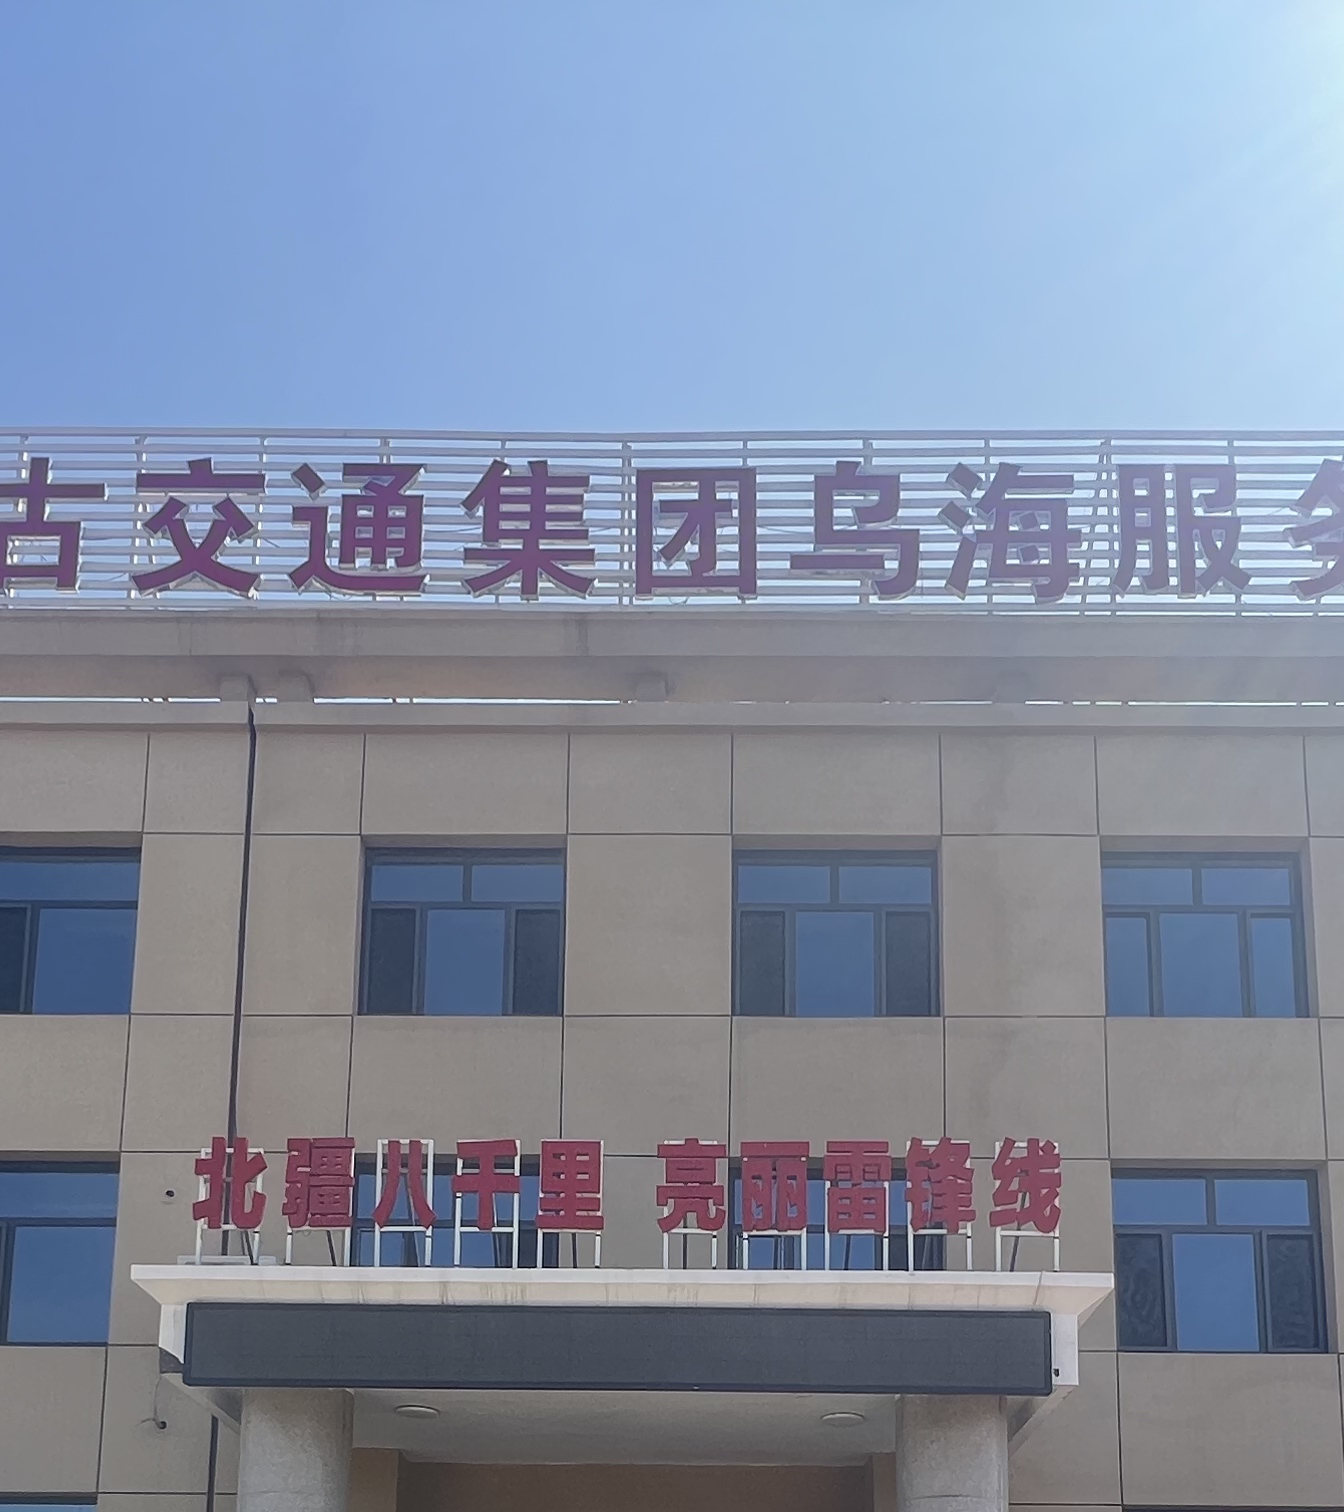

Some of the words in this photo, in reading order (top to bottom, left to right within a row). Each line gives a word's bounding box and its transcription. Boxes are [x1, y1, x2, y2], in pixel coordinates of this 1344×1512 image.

[193, 1136, 605, 1231] 北疆八千里
[657, 1137, 1063, 1235] 亮丽雷锋线
